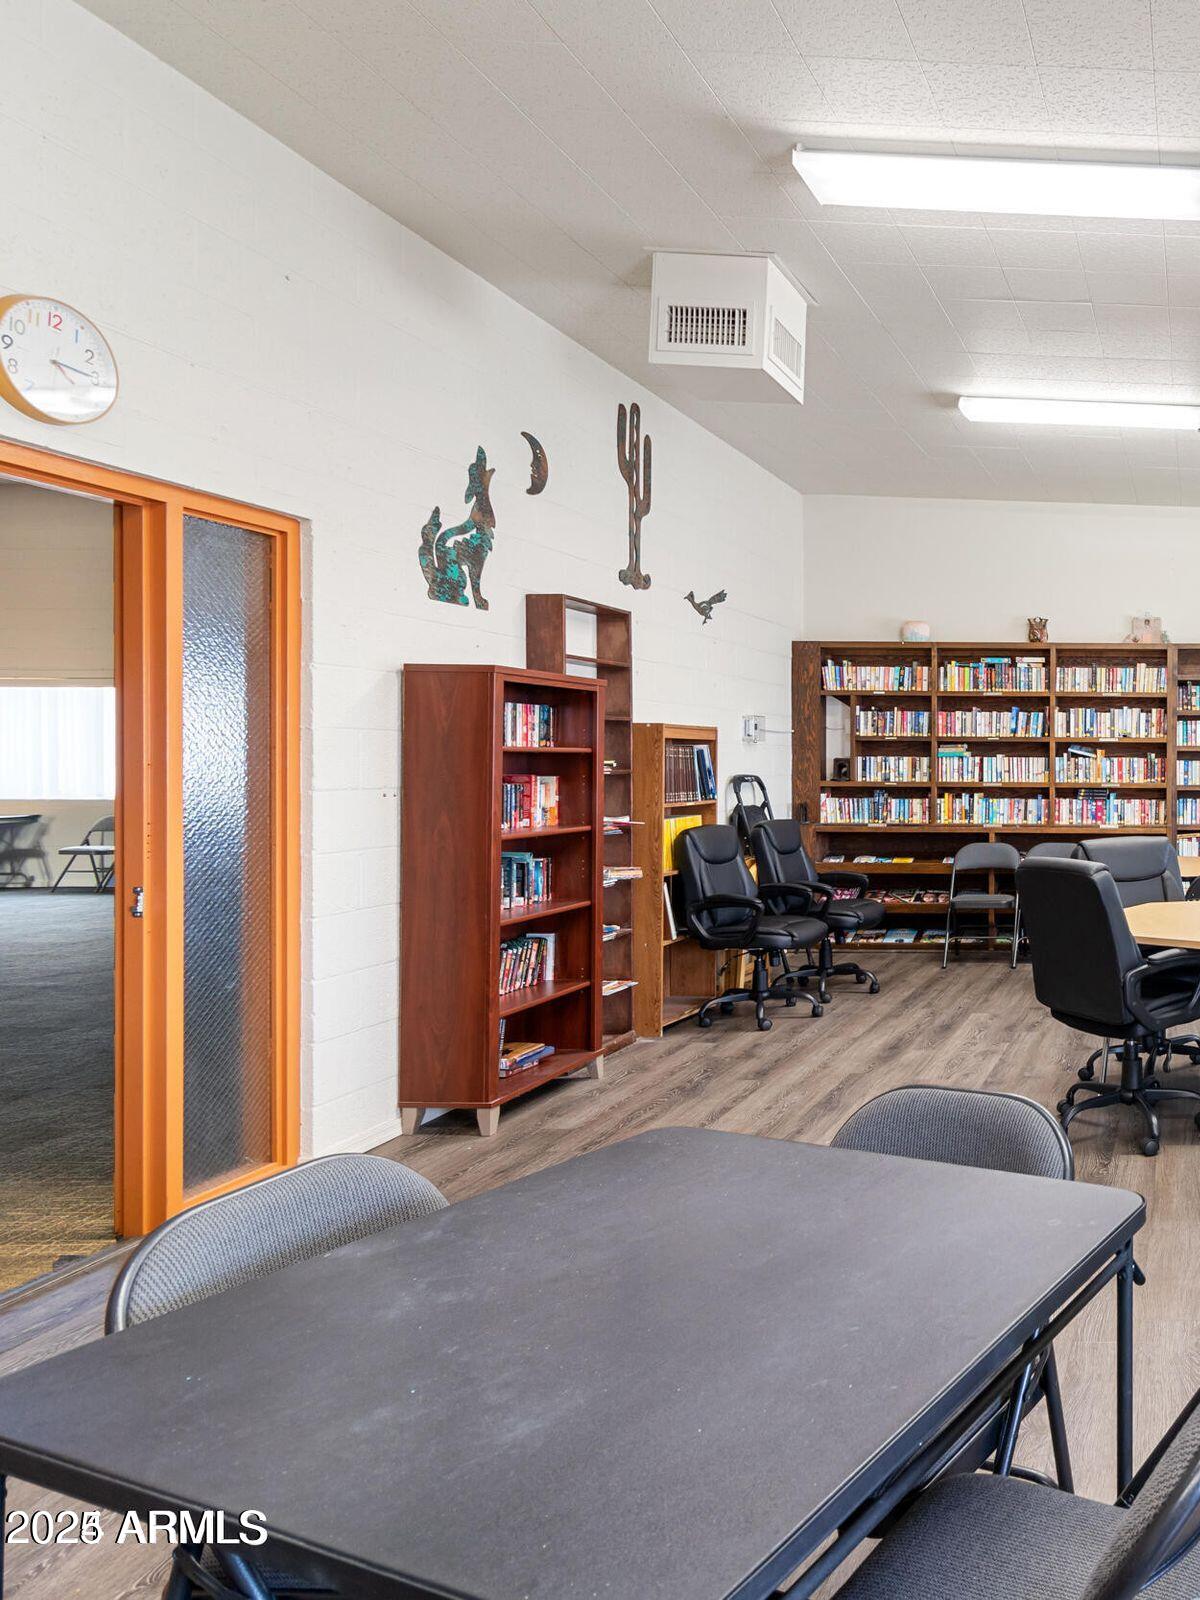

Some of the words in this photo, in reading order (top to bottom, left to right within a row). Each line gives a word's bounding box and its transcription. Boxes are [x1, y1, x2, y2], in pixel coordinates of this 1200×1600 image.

[9, 316, 26, 336] 10
[28, 308, 40, 327] 11
[47, 311, 63, 332] 12
[1, 334, 14, 350] 9
[75, 329, 79, 344] 1
[7, 358, 18, 374] 8
[84, 349, 95, 366] 2
